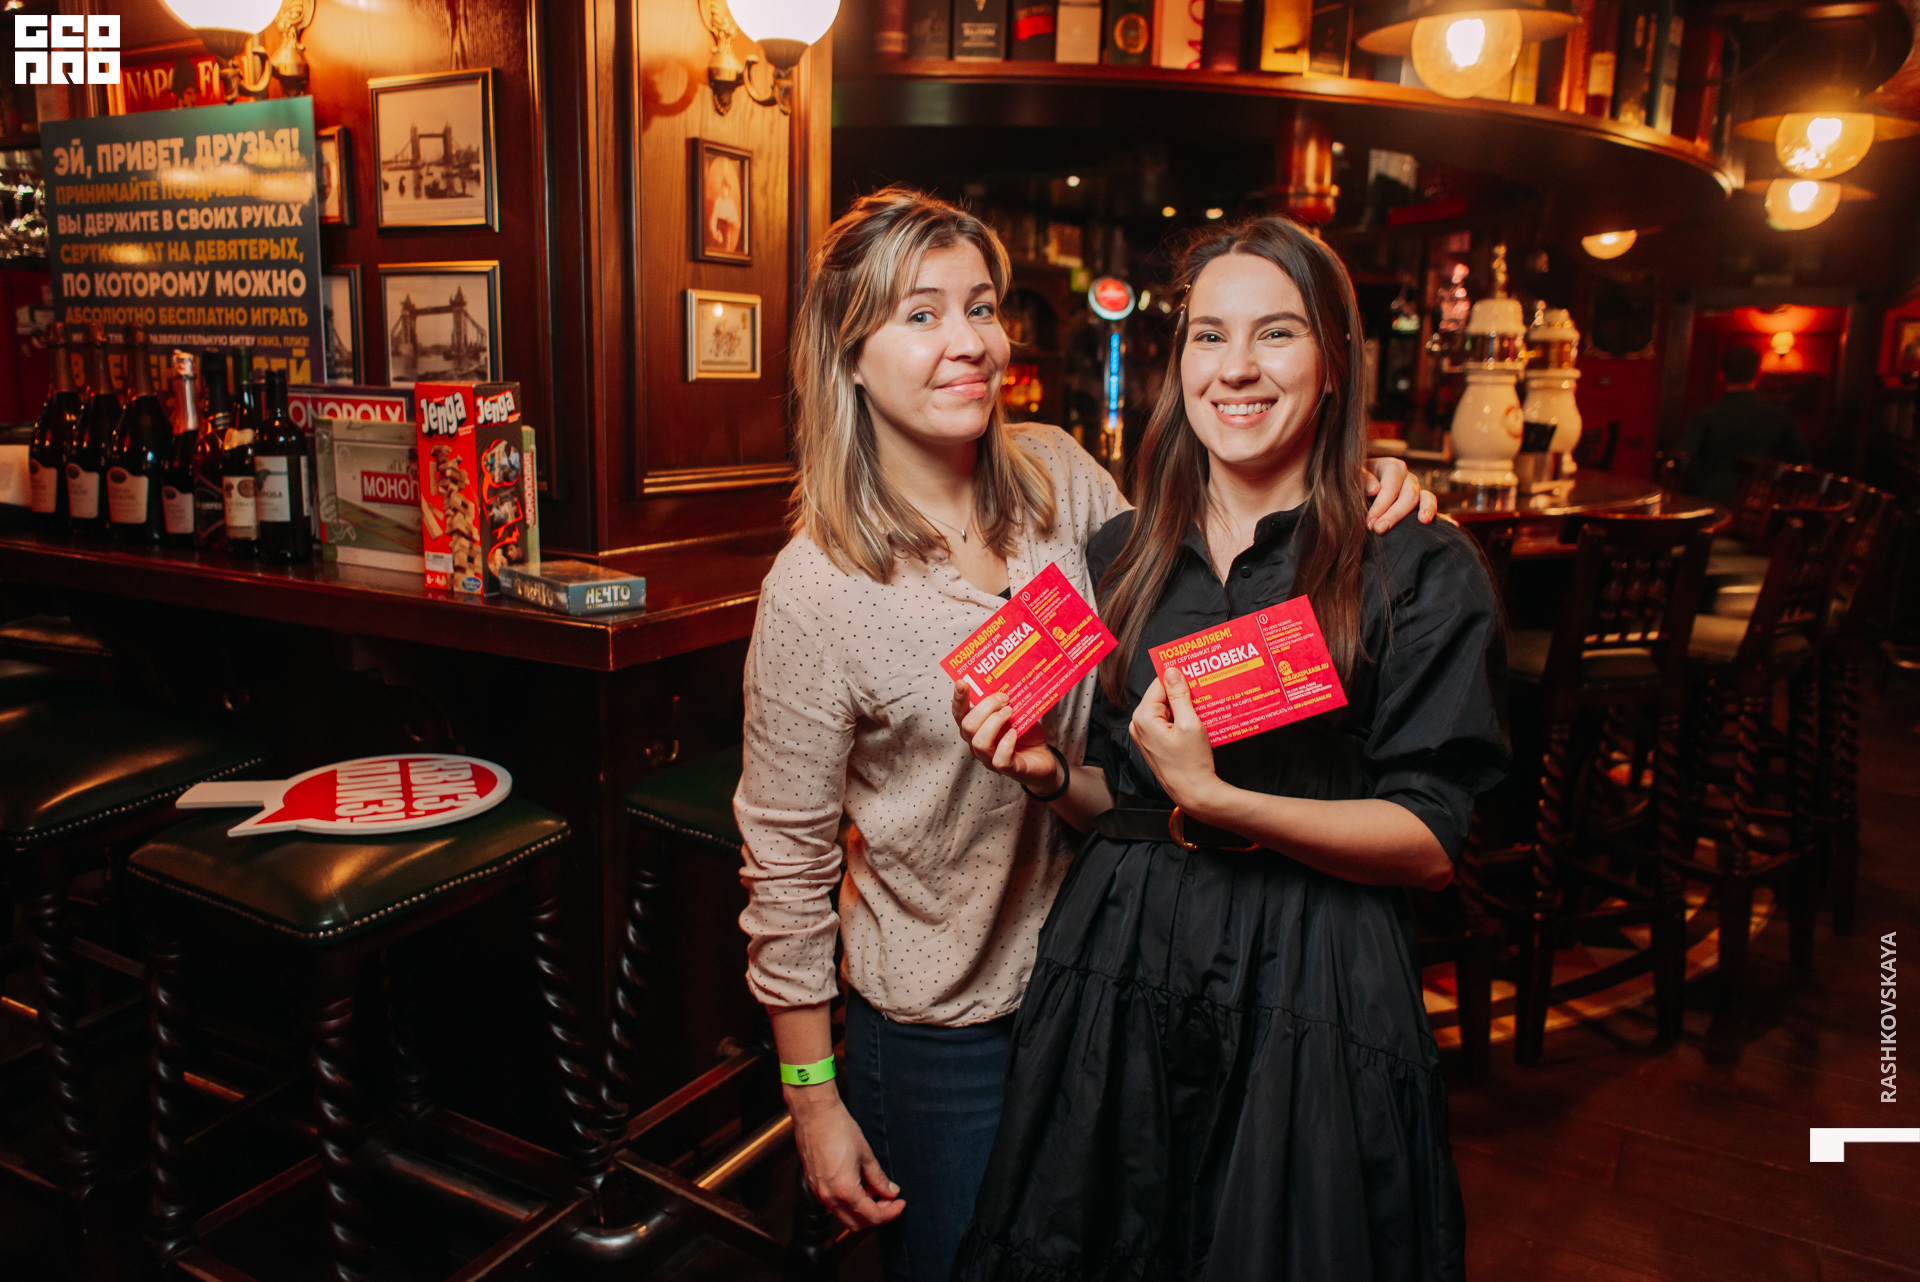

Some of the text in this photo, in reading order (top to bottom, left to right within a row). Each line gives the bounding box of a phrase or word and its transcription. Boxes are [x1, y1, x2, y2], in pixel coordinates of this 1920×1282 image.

[53, 127, 299, 179] ЭЙ, ПРИВЕТ, ДРУЗЬЯ!
[55, 176, 158, 205] ПРИНИМАЙТЕ
[57, 203, 303, 237] ВЫ ДЕРЖИТЕ В СВОИХ РУКАХ
[168, 241, 190, 263] НА
[194, 238, 304, 265] ДЕВЯТЕРЫХ,
[62, 269, 306, 297] ПО КОТОРОМУ МОЖНО
[65, 306, 308, 326] АБСОЛЮТНО БЕСПЛАТНО ИГРАТЬ
[421, 391, 467, 435] Jenga
[477, 391, 515, 424] Jenga
[363, 475, 420, 500] МОНОП
[585, 584, 631, 605] НЕЧТО
[948, 614, 1006, 669] ПОЗДРАВЛЯЕМ!
[956, 633, 1001, 675] ЭТОТ СЕРТИФИКАТ ДЛЯ
[973, 620, 1034, 677] ЧЕЛОВЕКА
[1158, 627, 1232, 661] ПОЗДРАВЛЯЕМ!
[1163, 643, 1221, 668] ЭТОТ СЕРТИФИКАТ ДЛЯ
[1181, 641, 1259, 680] ЧЕЛОВЕКА
[984, 673, 993, 684] №
[1188, 679, 1197, 688] №
